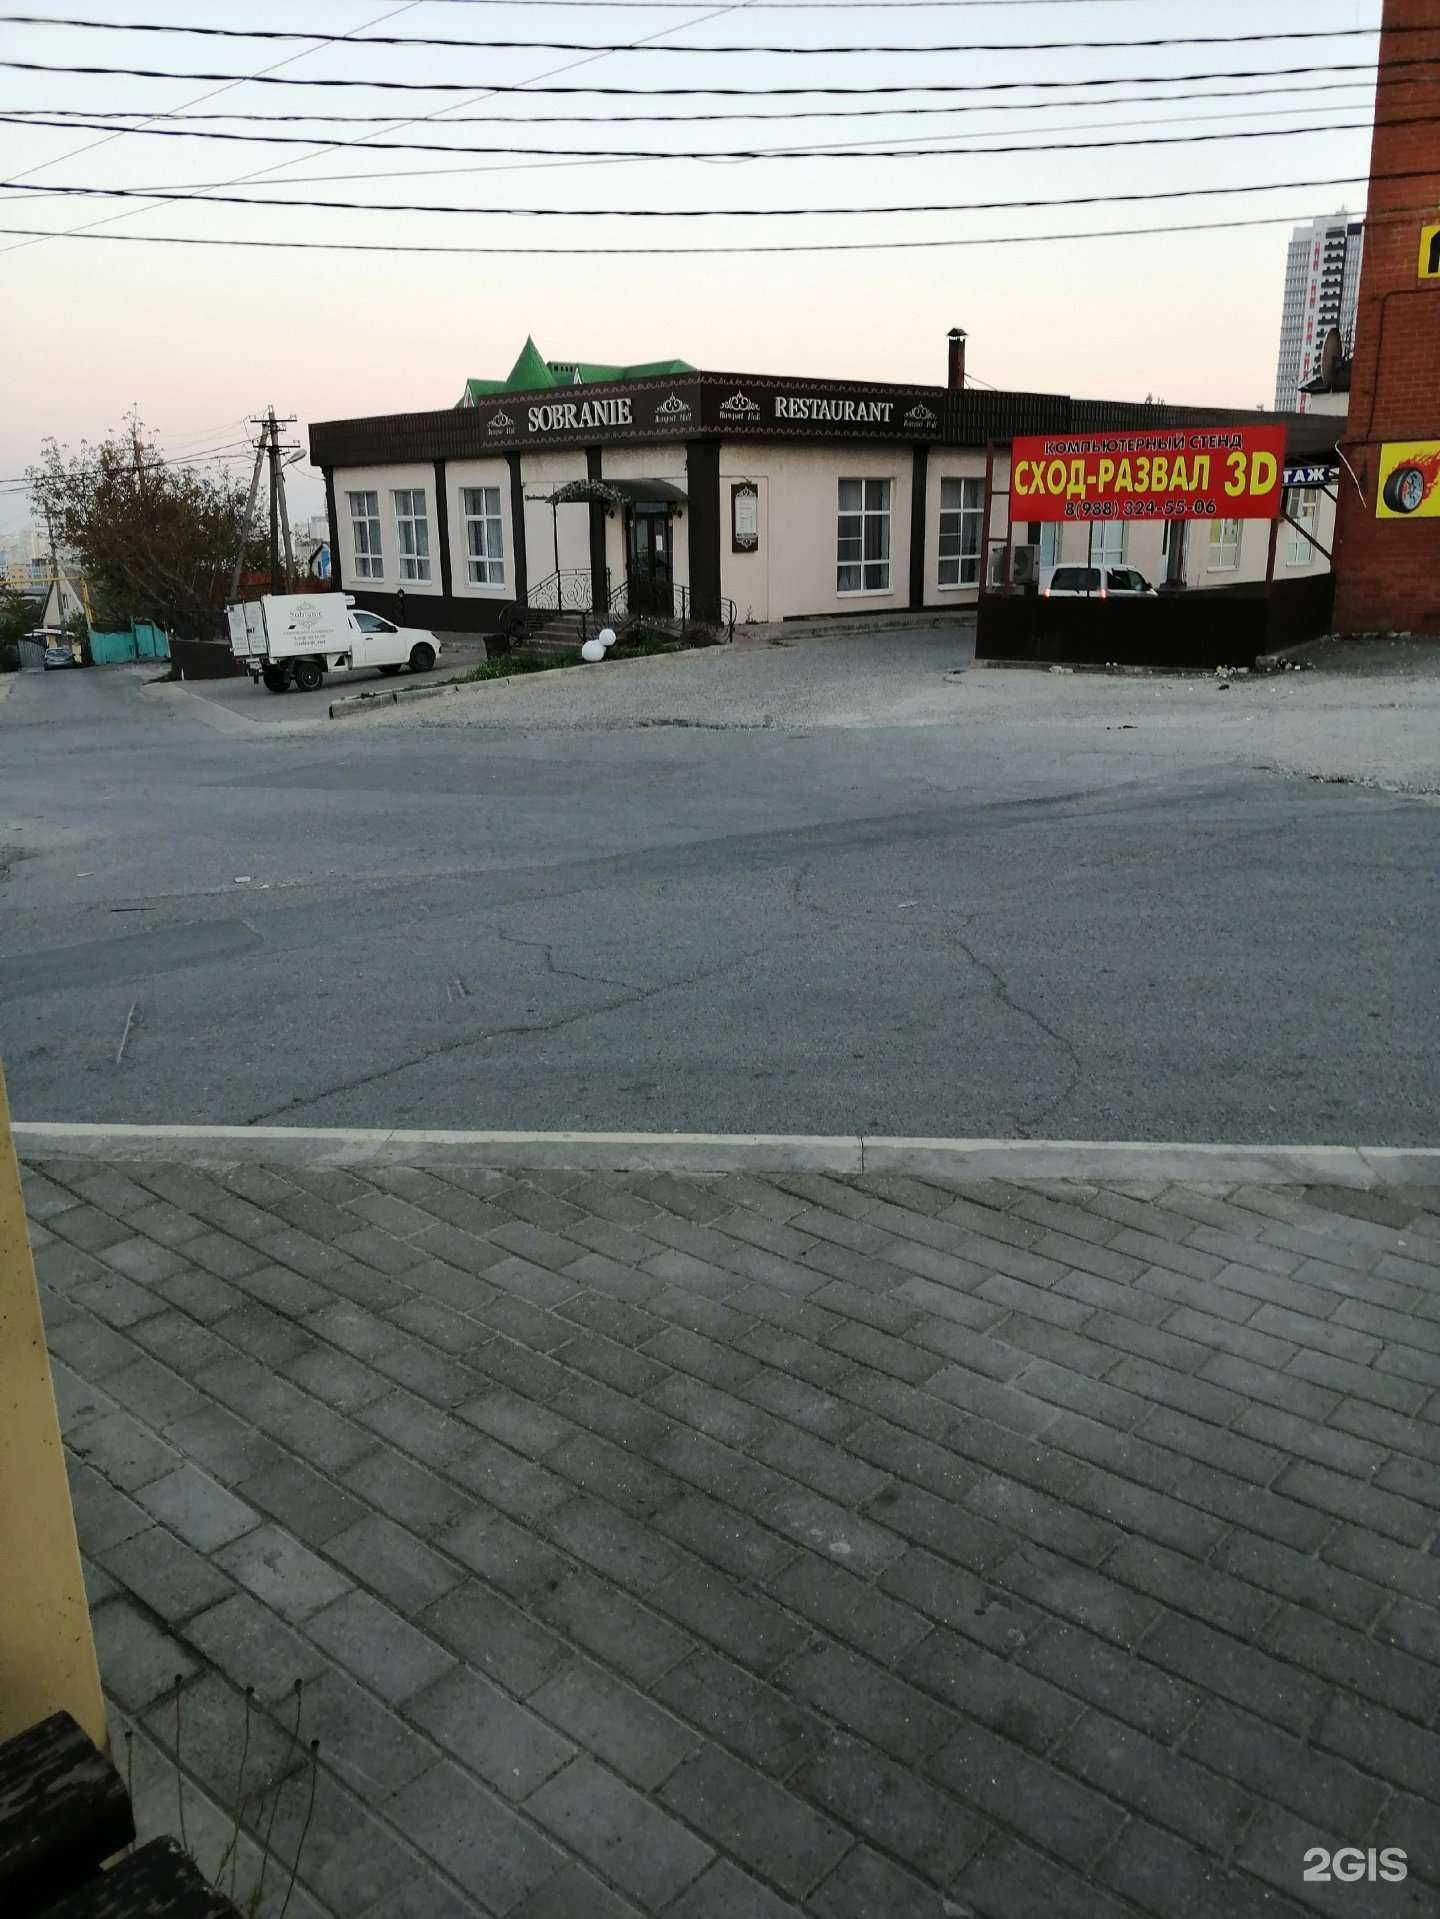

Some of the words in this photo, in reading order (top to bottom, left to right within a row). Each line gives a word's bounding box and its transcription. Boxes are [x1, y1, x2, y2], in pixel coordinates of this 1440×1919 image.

[528, 398, 633, 432] SOBRANIE
[775, 396, 894, 422] RESTAURANT
[1045, 433, 1185, 455] КОМПЬЮТЕРНЫЙ
[1189, 432, 1243, 449] СТЕНД
[1014, 455, 1210, 500] СХОД-РАЗВАЛ
[1224, 451, 1278, 497] 3D
[1064, 501, 1119, 519] 8(988)
[1123, 499, 1216, 516] 324-55-06
